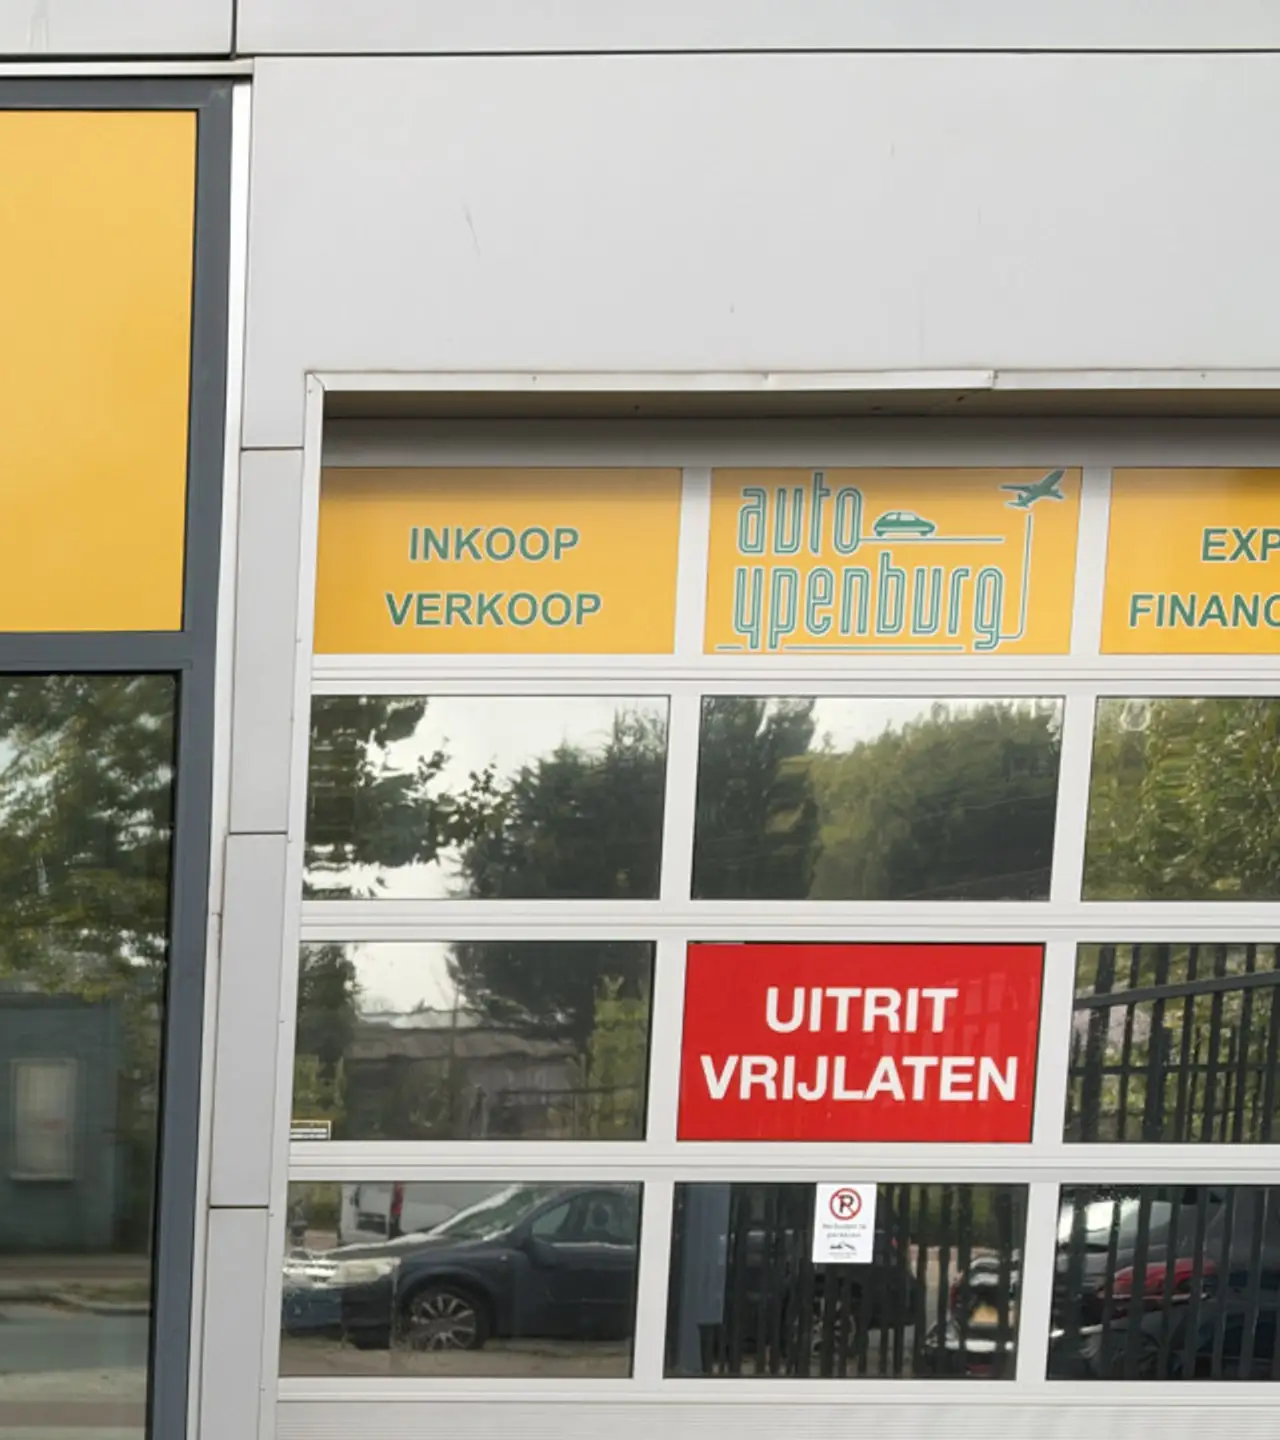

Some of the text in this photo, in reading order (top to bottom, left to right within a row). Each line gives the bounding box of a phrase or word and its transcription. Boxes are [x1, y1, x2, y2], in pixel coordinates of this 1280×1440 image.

[738, 471, 863, 556] auto
[408, 526, 580, 561] INKOOP
[385, 591, 602, 627] VERKOOP
[733, 551, 1005, 651] ypenburg
[765, 986, 959, 1033] UITRIT
[699, 1055, 1019, 1101] VRIJLATEN
